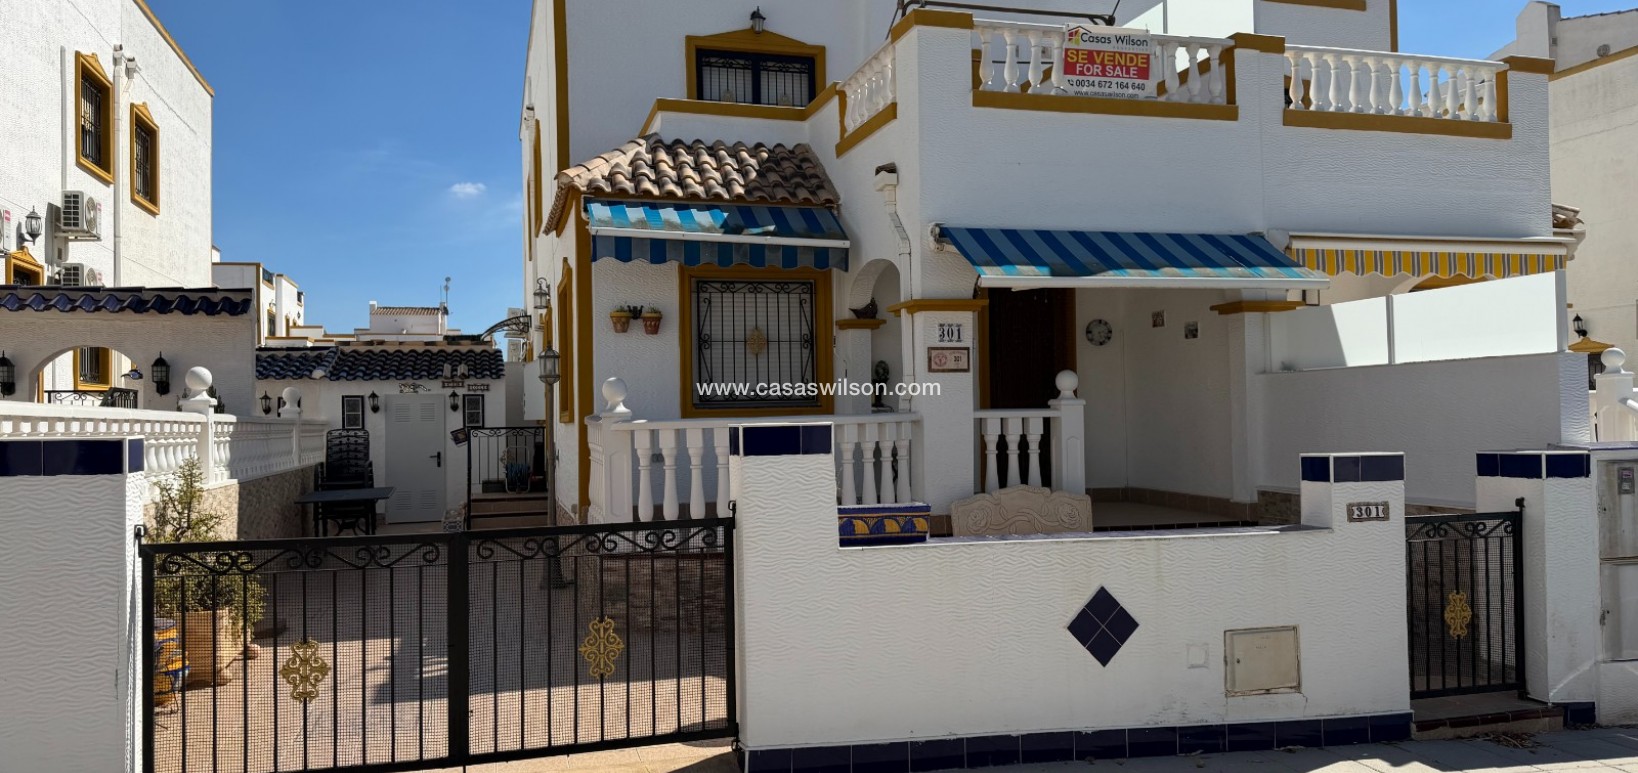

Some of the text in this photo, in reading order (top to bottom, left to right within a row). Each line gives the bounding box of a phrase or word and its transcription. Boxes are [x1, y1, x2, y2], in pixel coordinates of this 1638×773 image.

[1080, 32, 1149, 47] Casas Wilson
[1067, 49, 1148, 67] SE VENDE
[1076, 63, 1138, 78] FOR SALE
[1075, 79, 1146, 91] 0034 672 164 640
[1073, 90, 1139, 99] www.casaswilson.com
[938, 327, 962, 341] 301
[1356, 506, 1380, 518] 301
